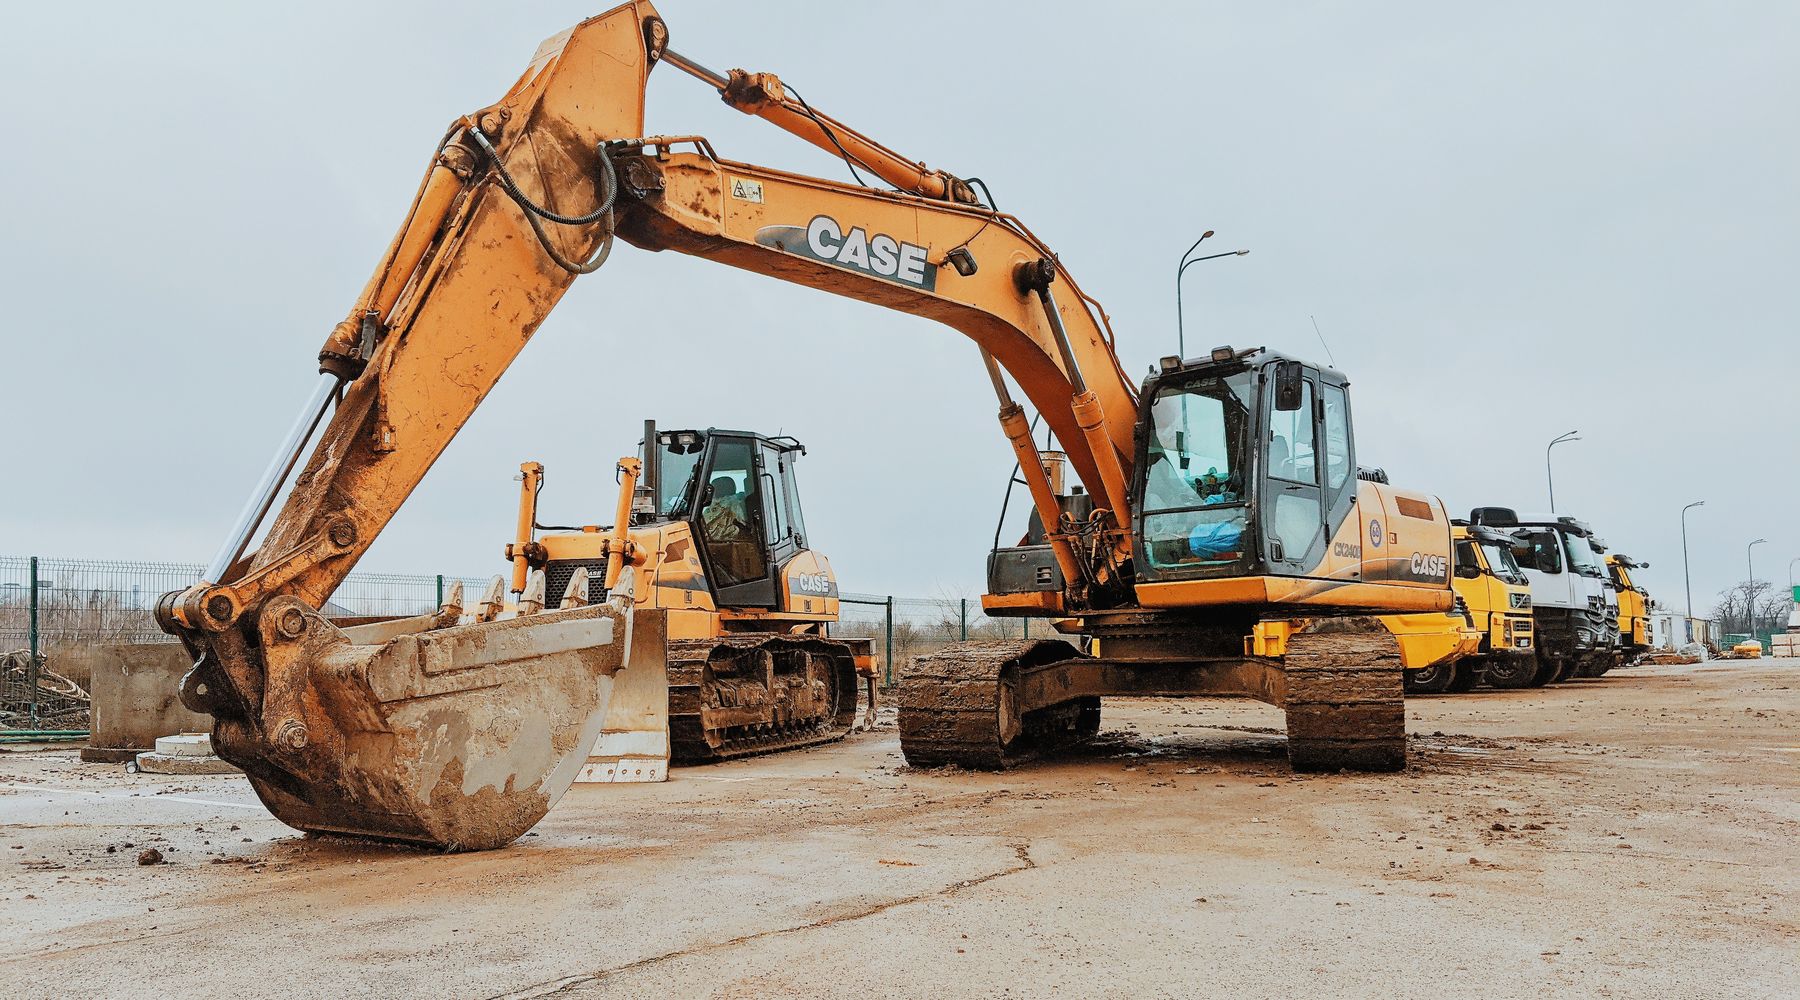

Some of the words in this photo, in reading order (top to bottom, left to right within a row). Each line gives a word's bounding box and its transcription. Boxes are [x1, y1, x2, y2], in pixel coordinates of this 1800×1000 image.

[807, 215, 927, 285] CASE
[1184, 377, 1217, 389] CASE
[1411, 552, 1446, 577] CASE
[799, 573, 829, 593] CASE
